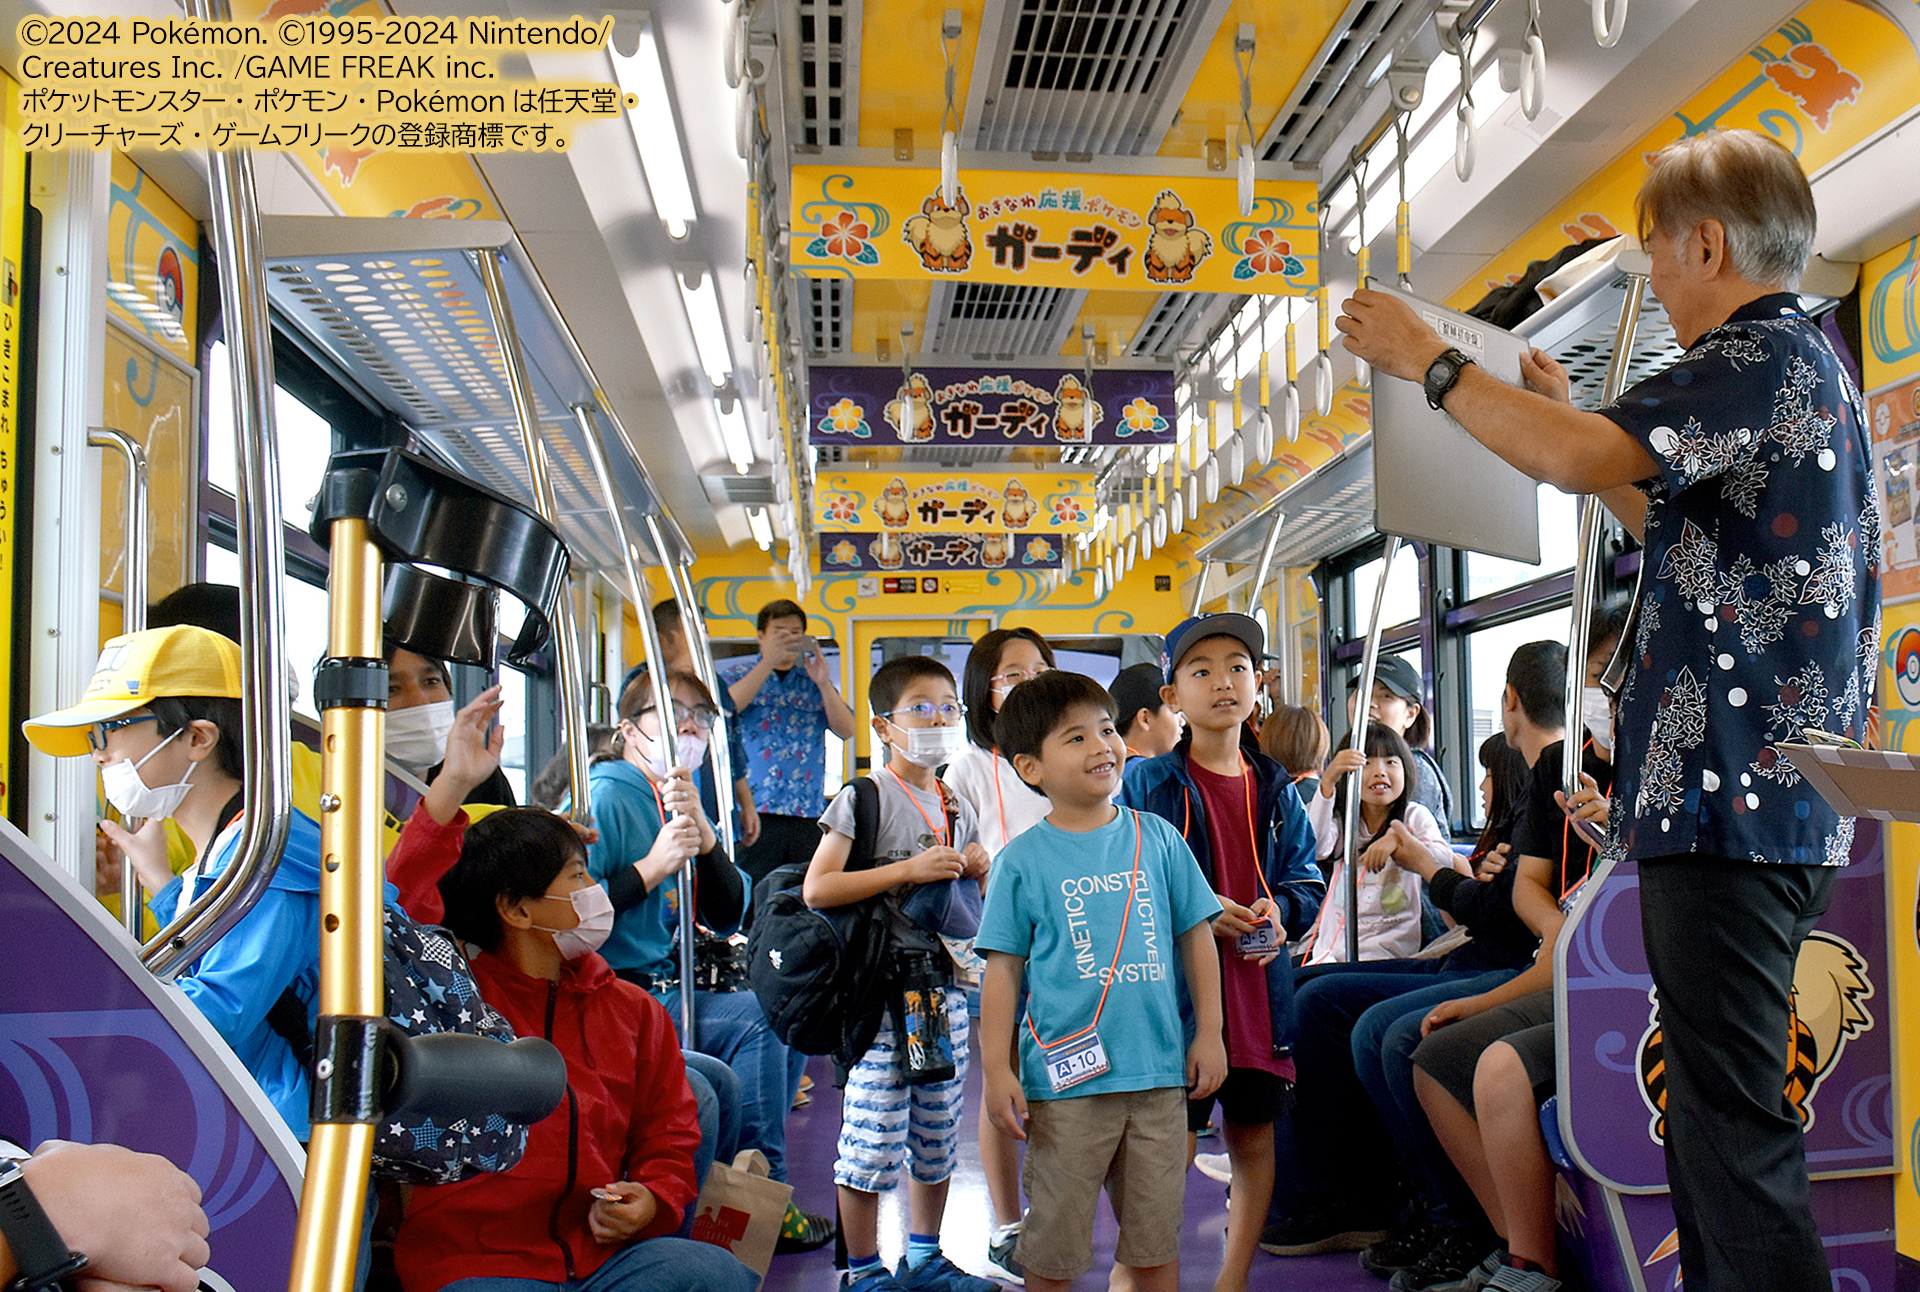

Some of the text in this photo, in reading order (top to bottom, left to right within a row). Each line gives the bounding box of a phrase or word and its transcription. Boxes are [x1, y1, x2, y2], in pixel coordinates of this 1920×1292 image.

[985, 222, 1134, 275] ガーディ
[944, 401, 1048, 436] ガーディ
[917, 498, 996, 525] ガーディ
[909, 541, 977, 563] ガーディ
[1064, 896, 1097, 980] KINETIC
[1098, 962, 1166, 987] SYSTEM
[1057, 1050, 1097, 1078] A-10
